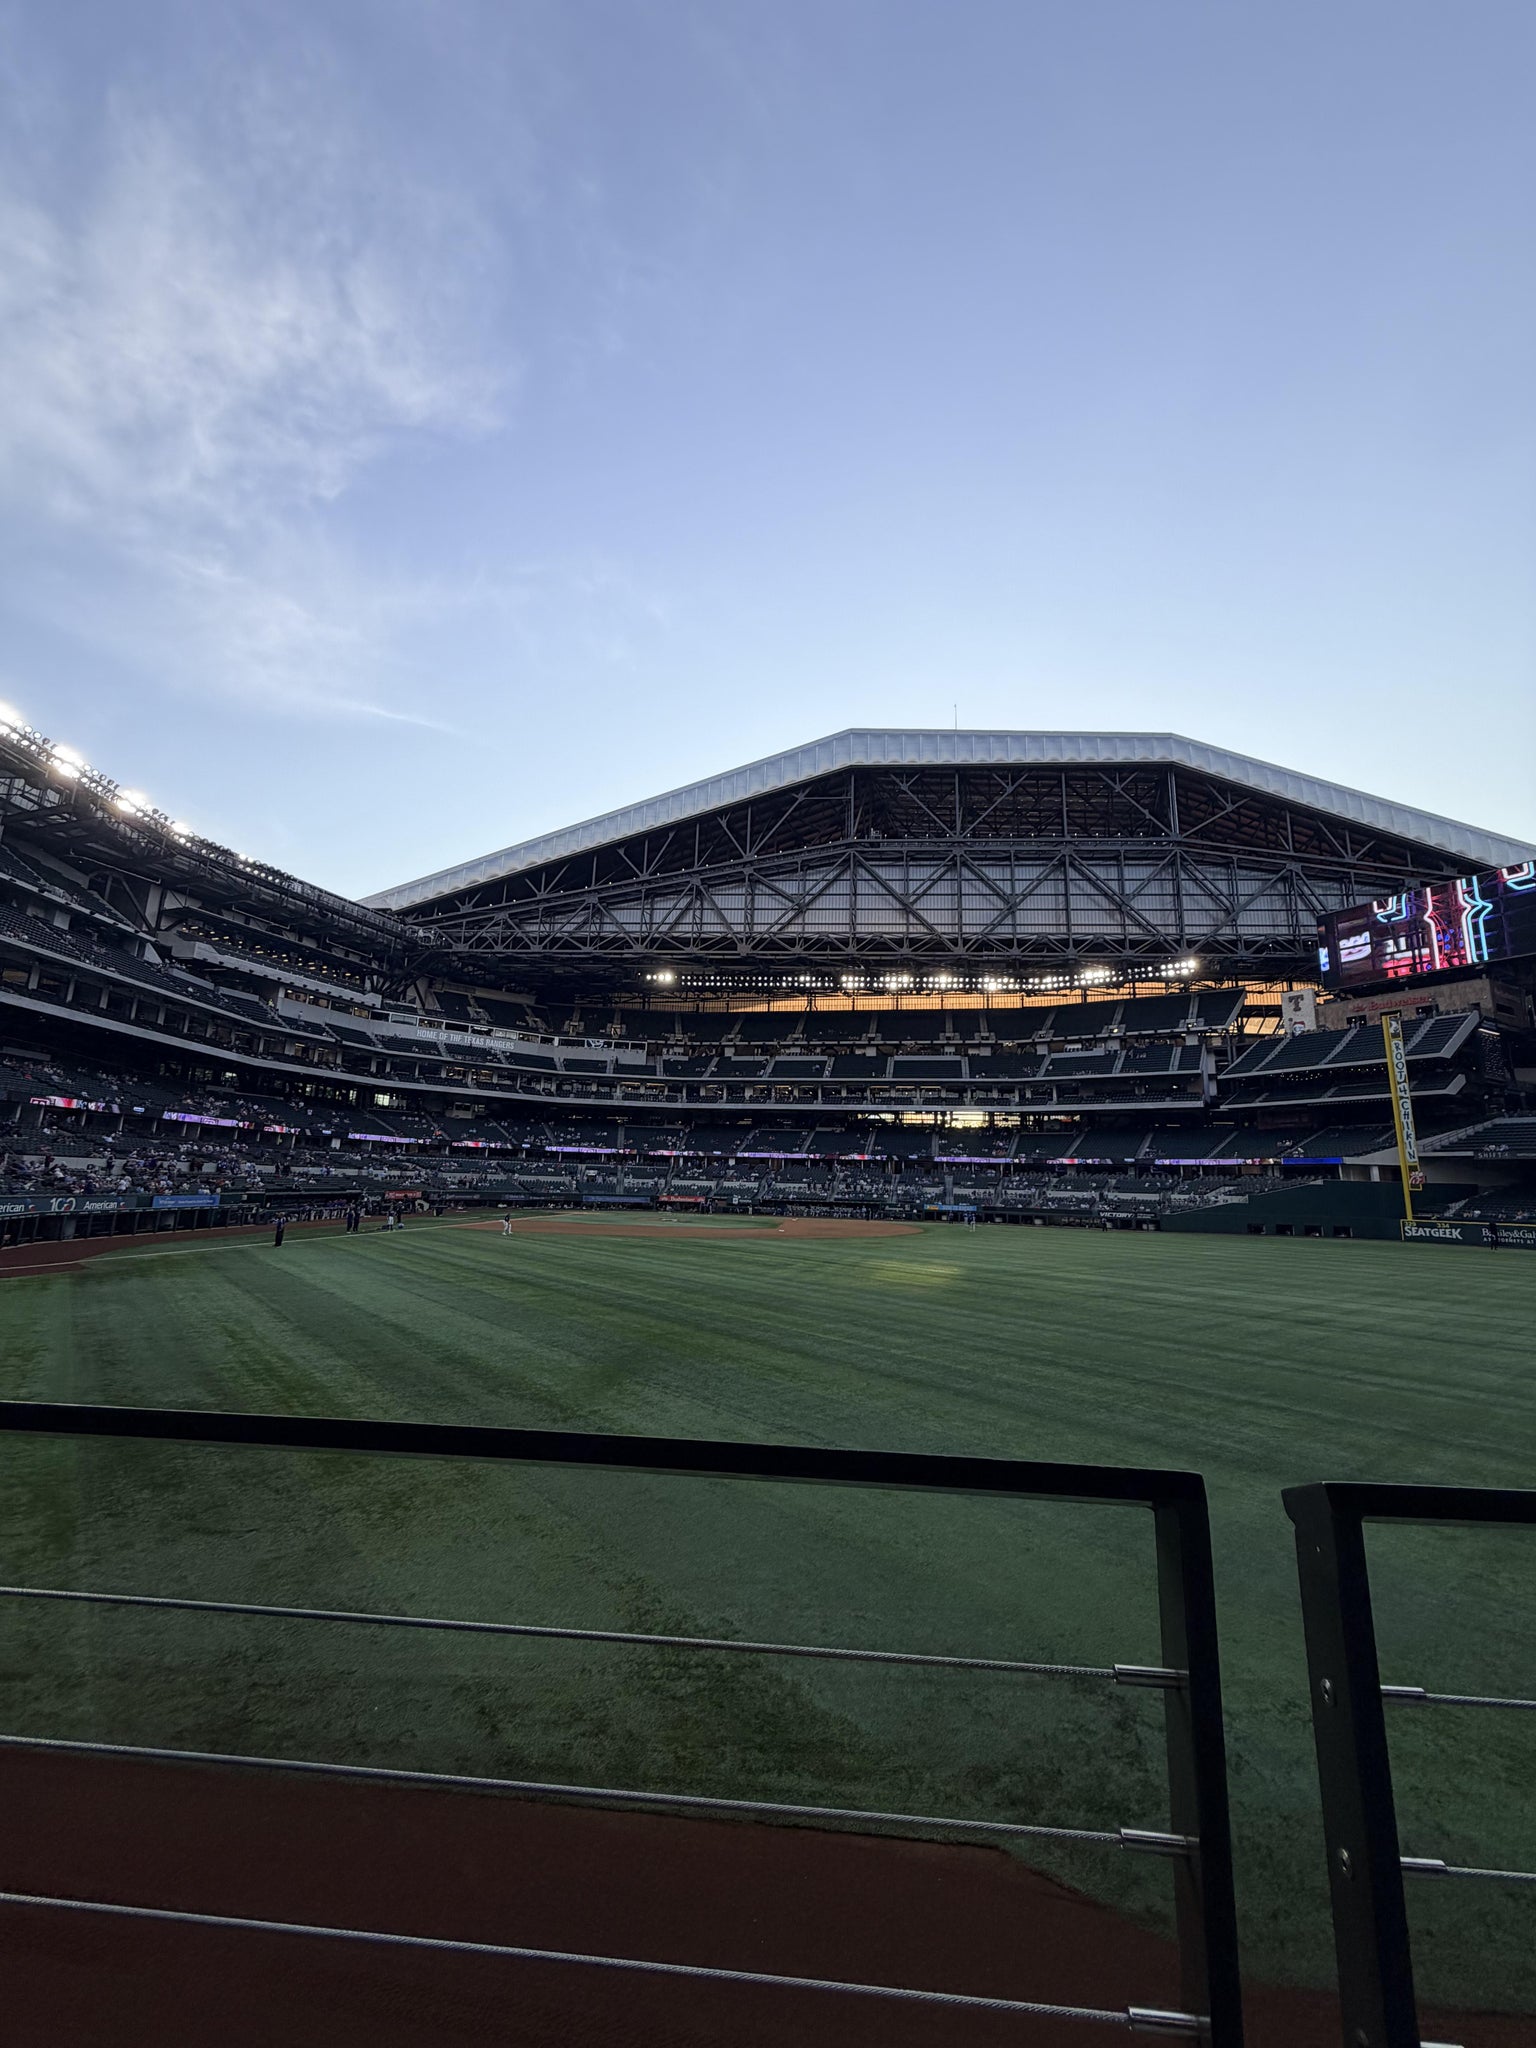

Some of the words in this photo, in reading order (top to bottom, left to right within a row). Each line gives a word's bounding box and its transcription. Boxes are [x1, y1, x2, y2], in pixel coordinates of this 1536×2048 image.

[1288, 994, 1304, 1012] T
[1369, 996, 1431, 1011] Budweiser
[417, 1029, 437, 1039] HOME
[439, 1032, 448, 1040] OF
[450, 1034, 462, 1042] THE
[464, 1035, 484, 1046] TEXAS
[485, 1038, 515, 1050] RANGERS
[1401, 1100, 1416, 1160] CHIKIN
[83, 1201, 118, 1211] American
[1404, 1226, 1463, 1240] SEATGEEK
